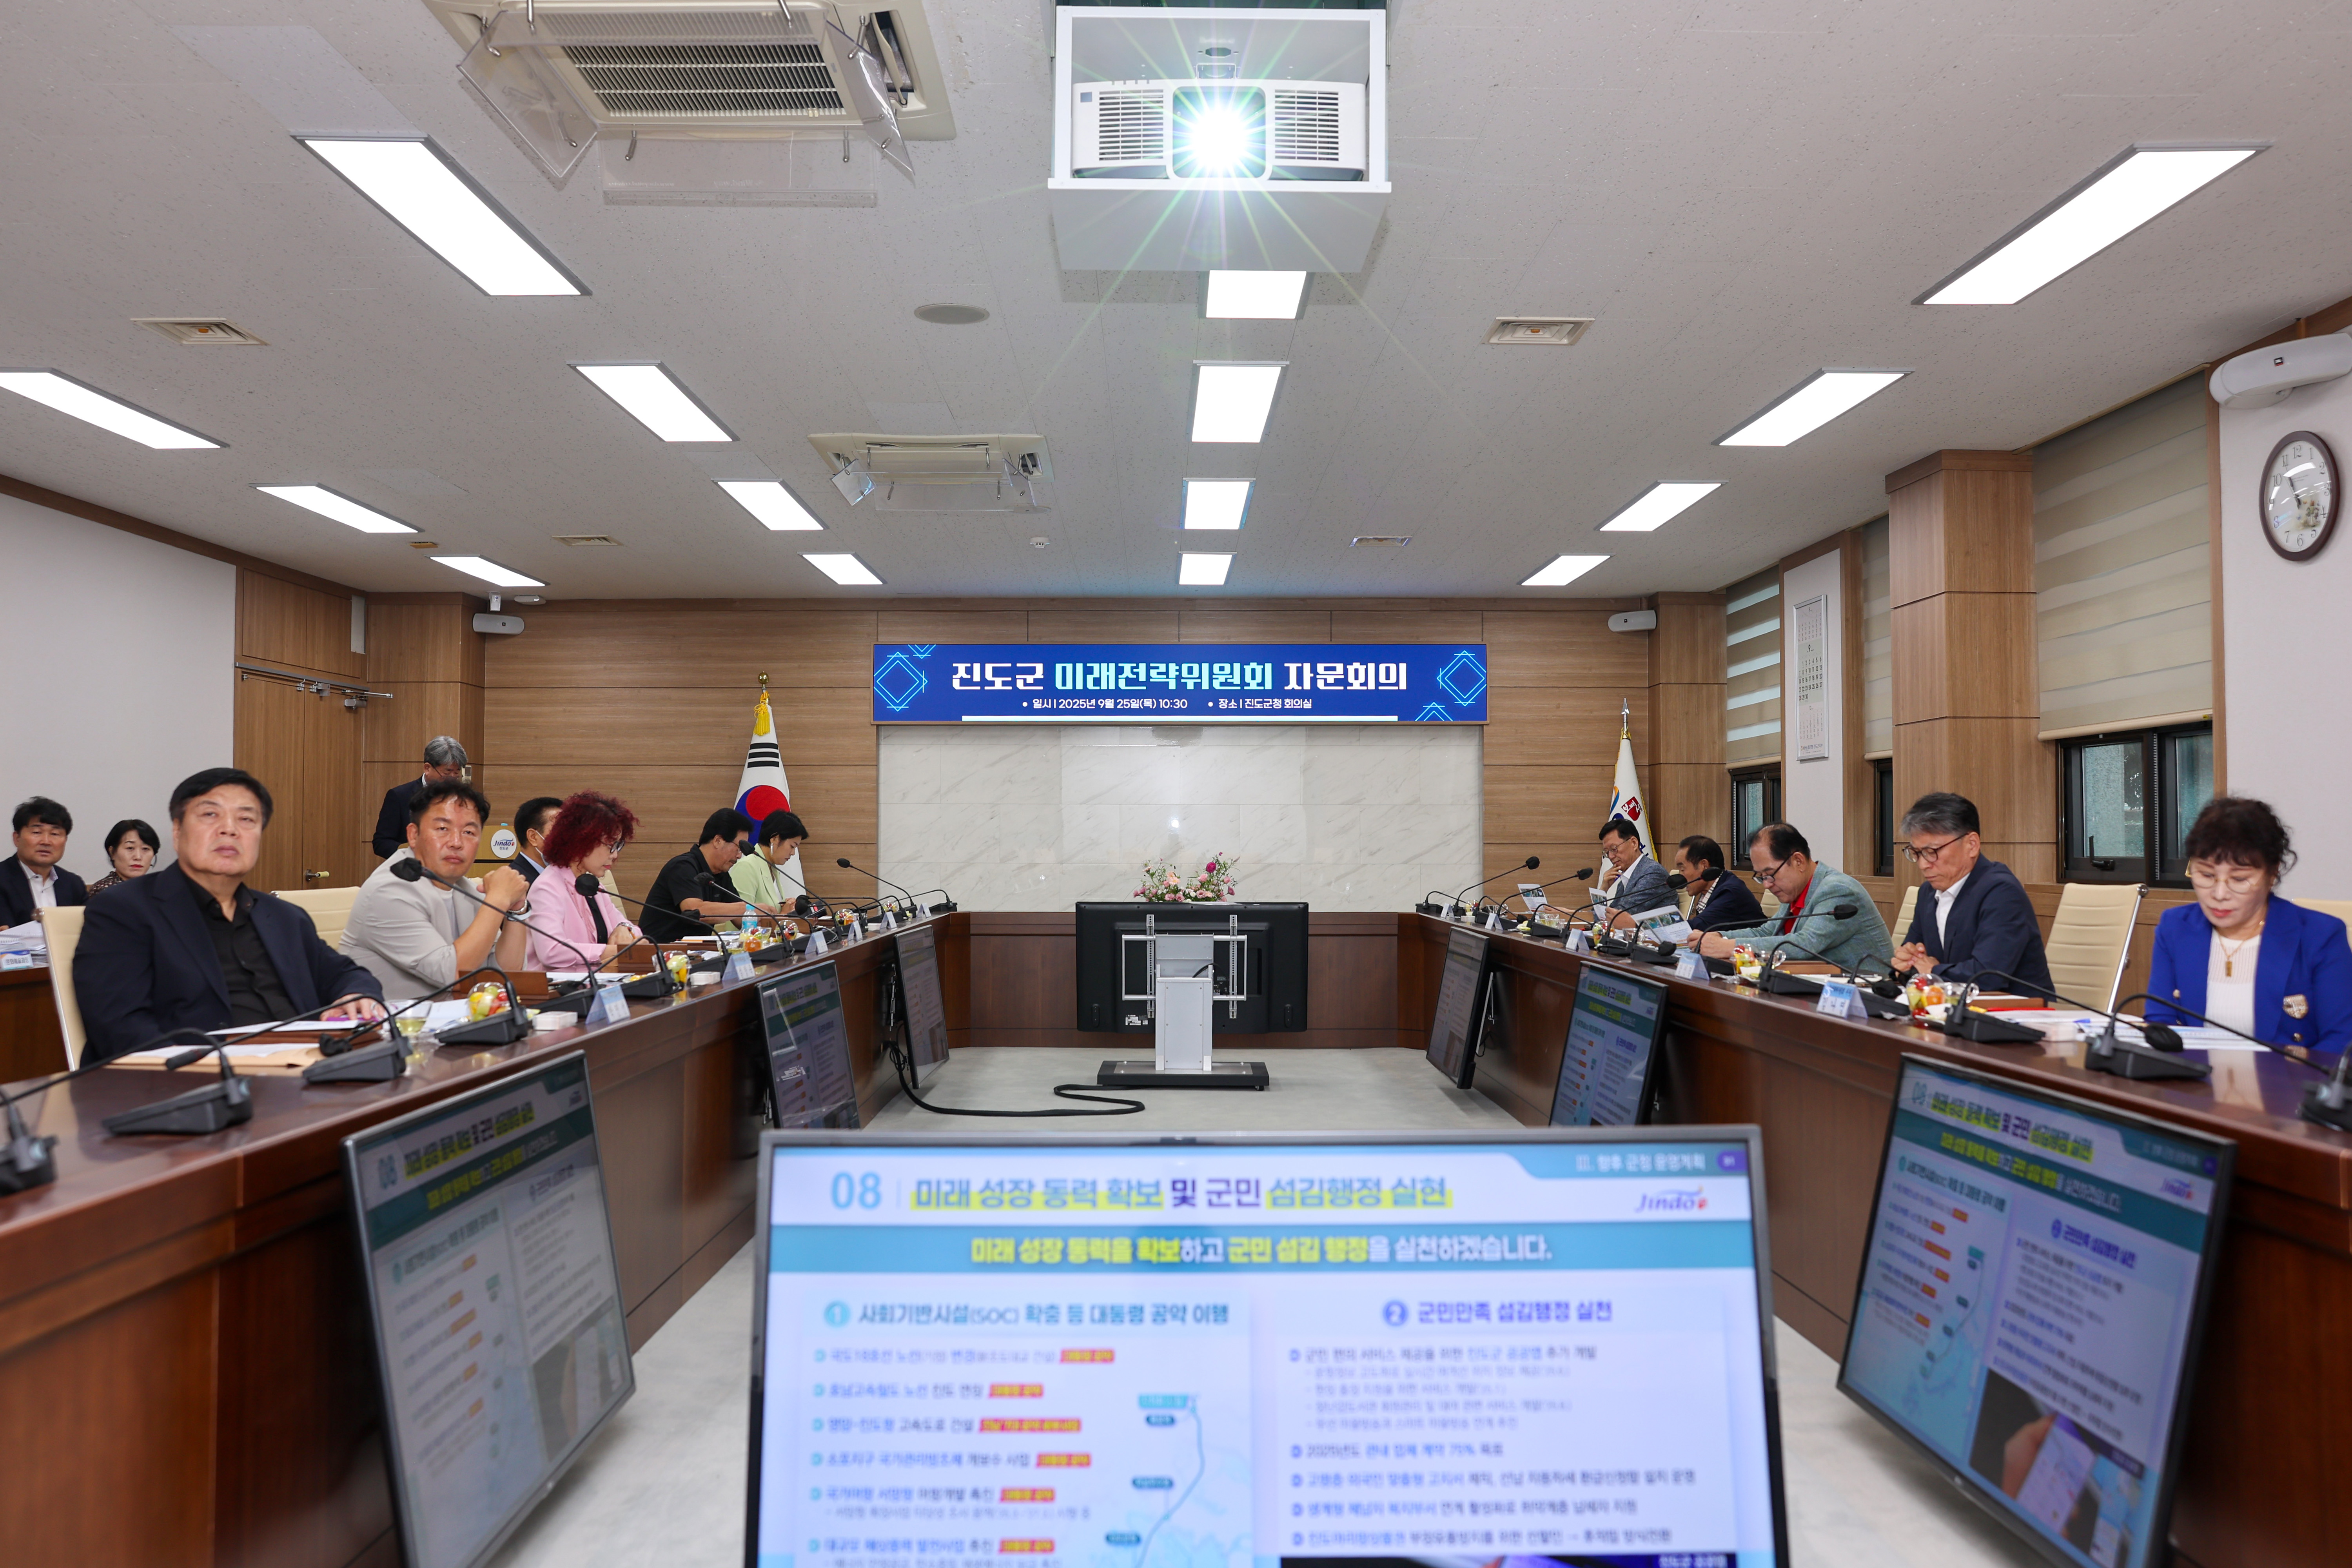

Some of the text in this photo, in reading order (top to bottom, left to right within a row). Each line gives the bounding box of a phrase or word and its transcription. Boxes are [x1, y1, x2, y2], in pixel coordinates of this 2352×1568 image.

[2293, 445, 2301, 459] 12
[2309, 448, 2313, 459] 1
[2282, 454, 2288, 467] 11
[2319, 462, 2325, 474] 2
[2274, 473, 2281, 486] 10
[2324, 483, 2330, 496] 3
[2320, 505, 2328, 518] 4
[2274, 515, 2279, 528] 8
[2285, 530, 2290, 543] 7
[2297, 534, 2303, 546] 6
[2311, 529, 2316, 538] 5
[952, 662, 1407, 690] 진도군 미래전략위원회 자문회의
[1033, 698, 1312, 709] 일시 2025년 9월 25일(목) 10:30 장소 진도군청 회의실
[830, 1172, 1446, 1210] 08 미래 성장 동력 확보 및 군민 섬김행정 실현
[1635, 1193, 1696, 1213] Jindo
[971, 1236, 1553, 1265] 미래 성장 동력을 확보하고 군민 섬김 행정을 실천하겠습니다.
[1090, 1304, 1145, 1325] 대통령
[1419, 1302, 1491, 1323] 군민만족
[1498, 1301, 1570, 1323] 섬김행정
